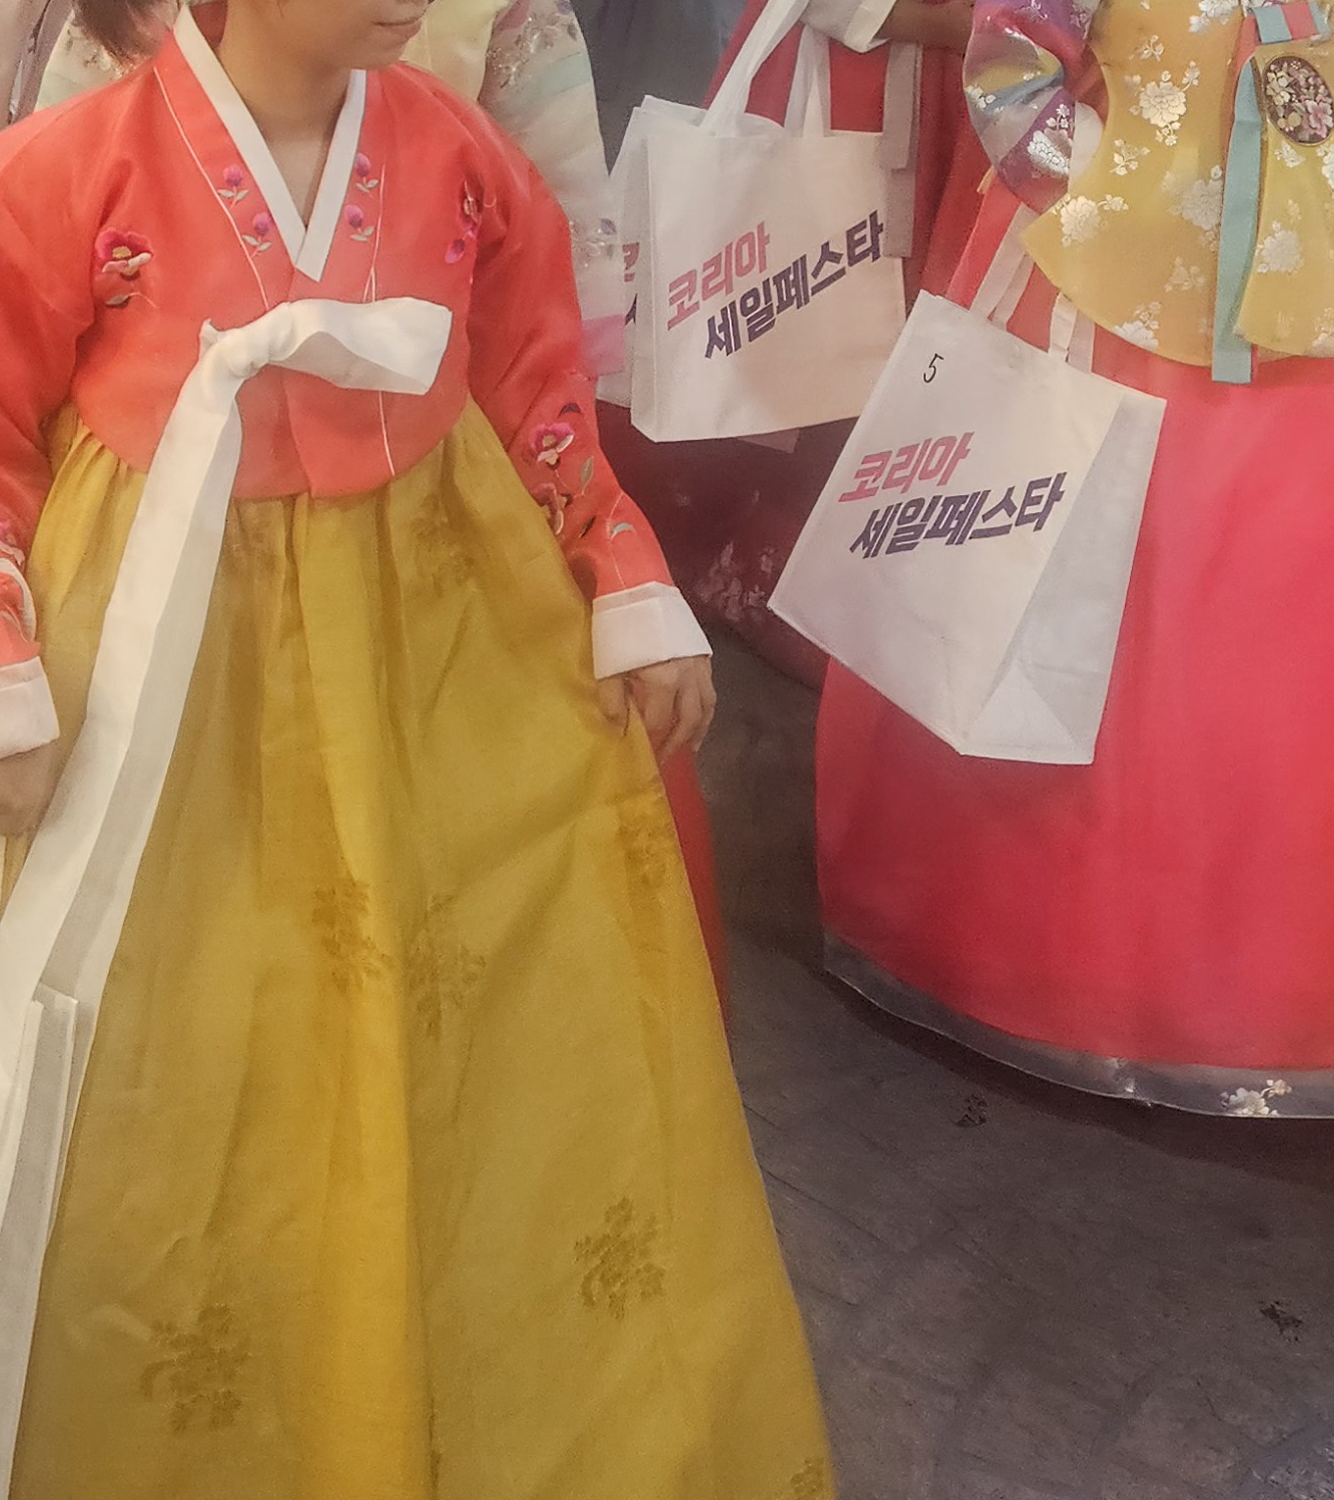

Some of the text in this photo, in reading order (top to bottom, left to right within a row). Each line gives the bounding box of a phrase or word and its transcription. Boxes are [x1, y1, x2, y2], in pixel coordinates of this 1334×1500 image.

[667, 220, 770, 332] 코리아
[704, 210, 884, 359] 세일페스타
[923, 353, 945, 384] 5
[838, 431, 975, 503] 코리아
[849, 472, 1067, 559] 세일페스타
